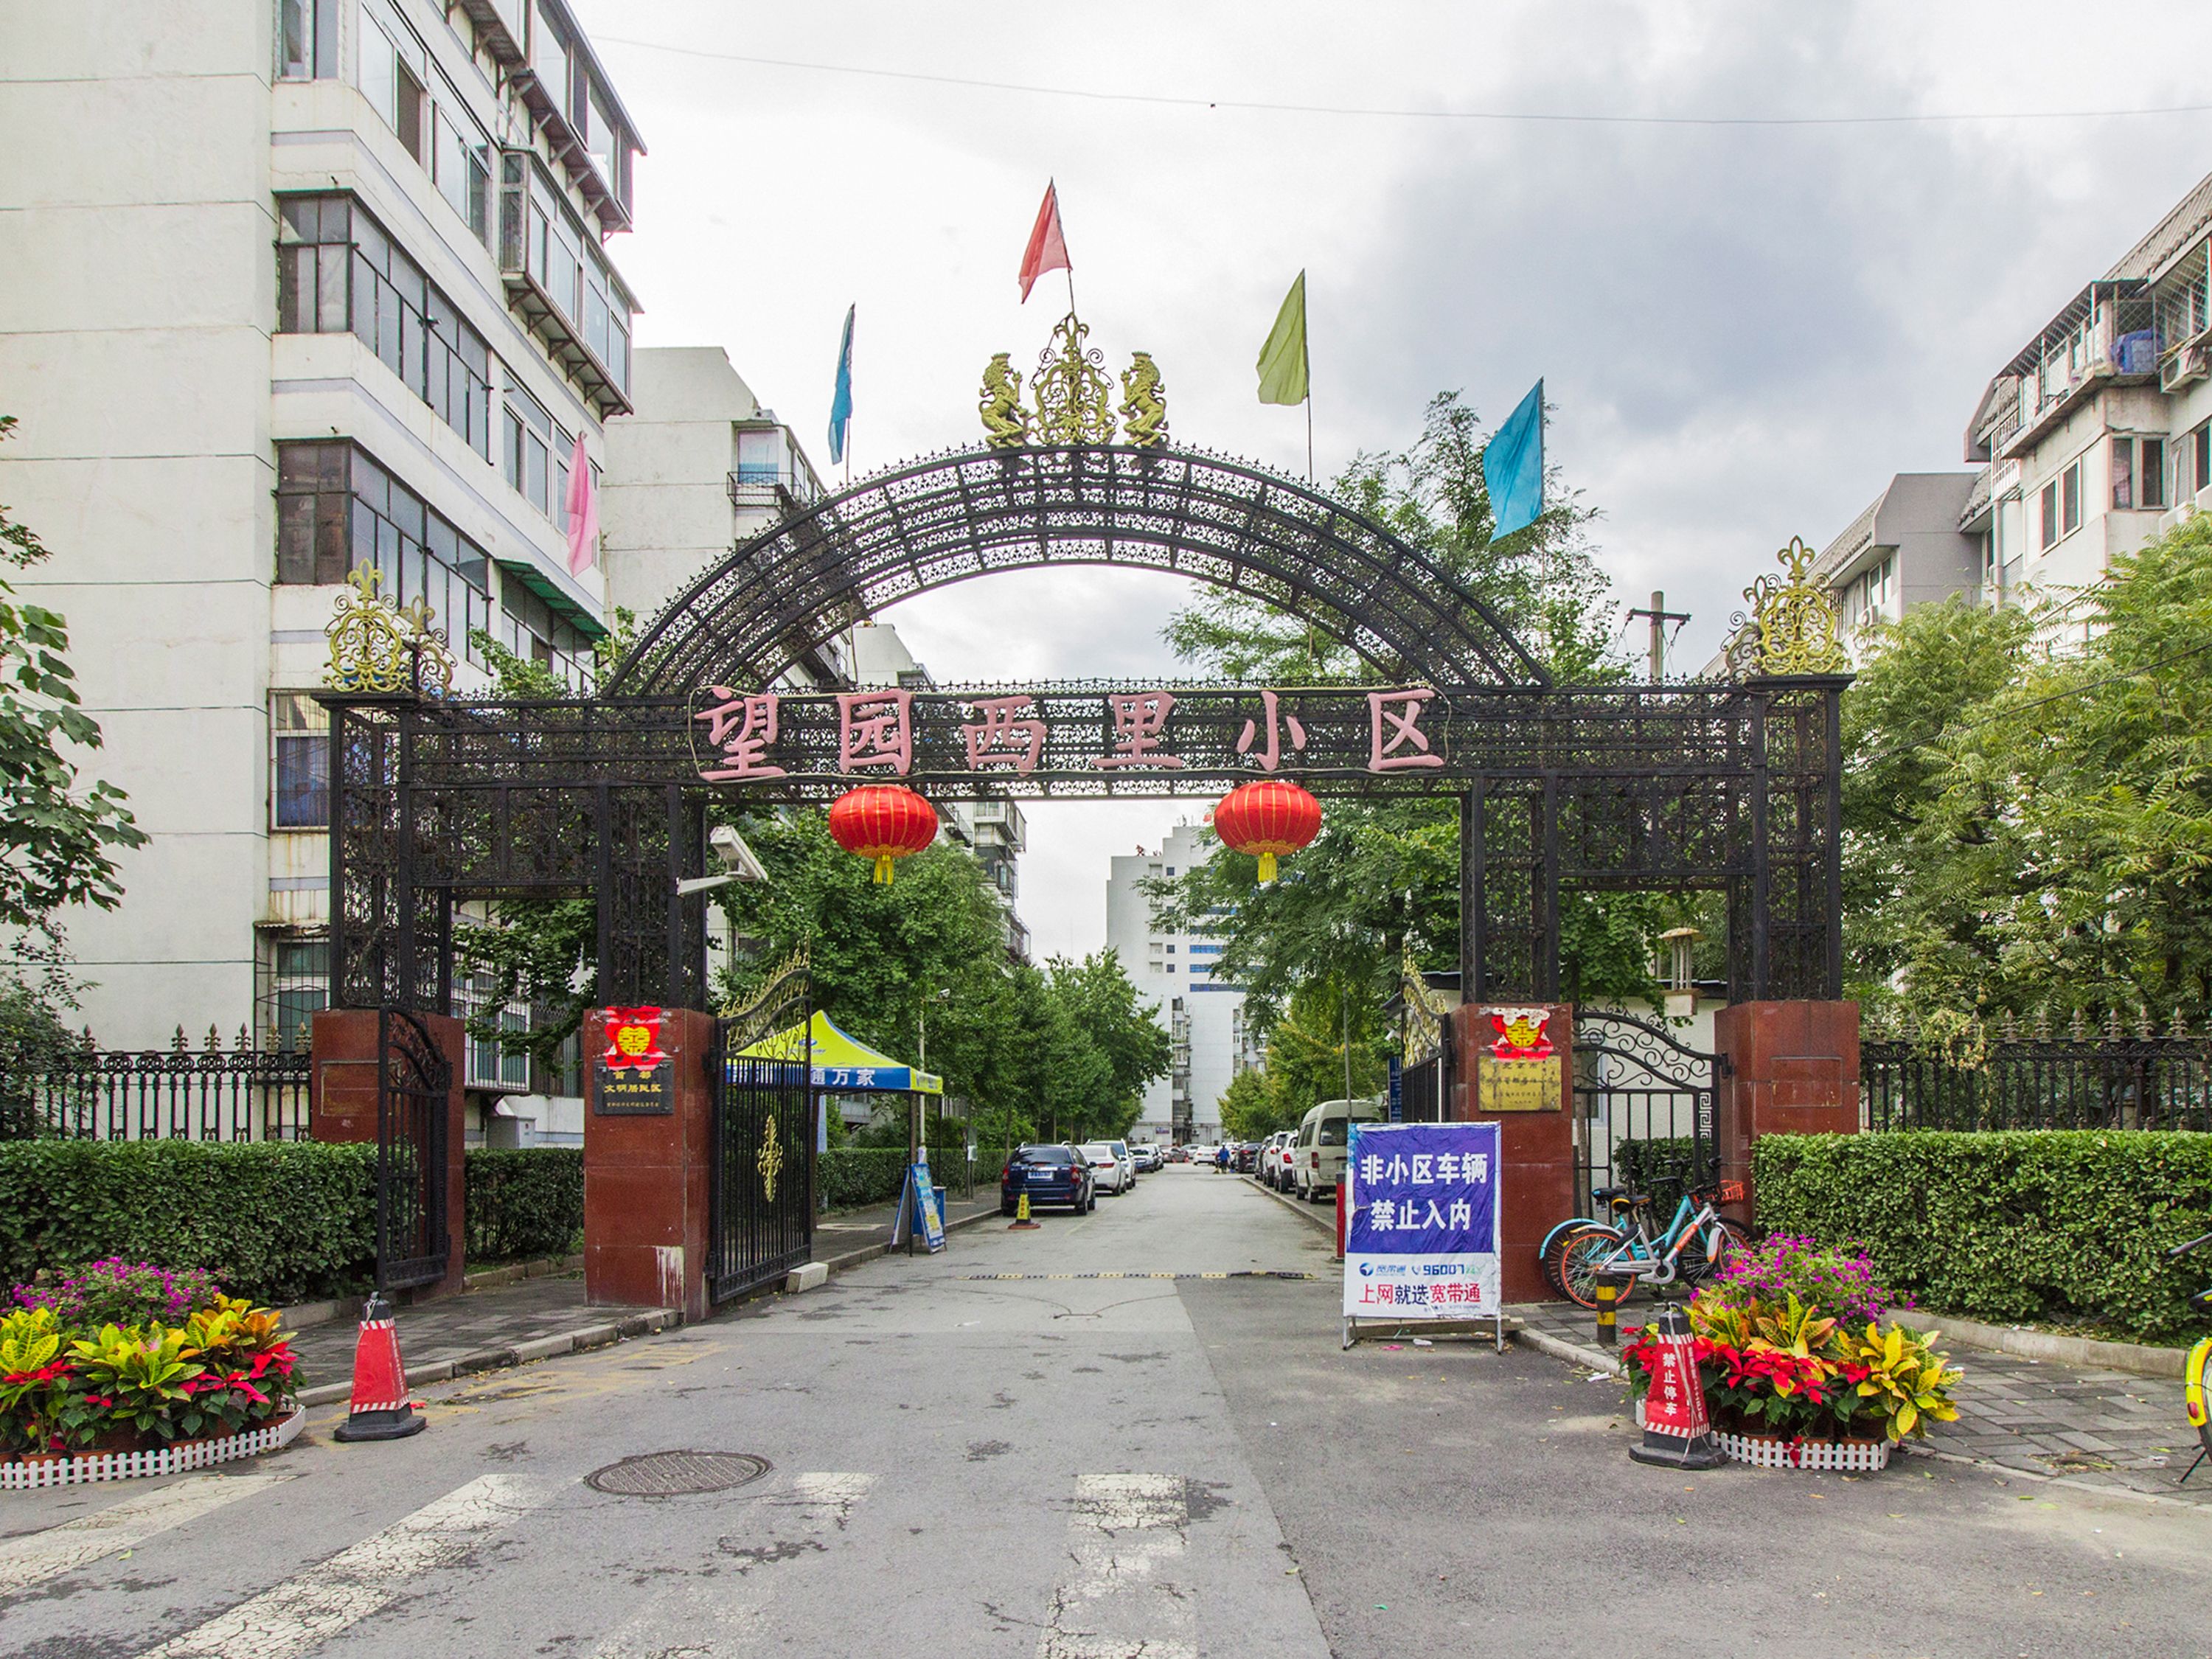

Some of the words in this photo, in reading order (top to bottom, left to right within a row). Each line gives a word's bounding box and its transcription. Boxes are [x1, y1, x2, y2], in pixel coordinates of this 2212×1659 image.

[695, 686, 1445, 781] 望园西里小区
[1360, 1152, 1487, 1185] 非小区车辆
[1370, 1197, 1472, 1231] 禁止入内
[1424, 1265, 1464, 1275] 96007
[1359, 1282, 1481, 1304] 上网就选宽带通
[1663, 1353, 1677, 1416] 禁止停车
